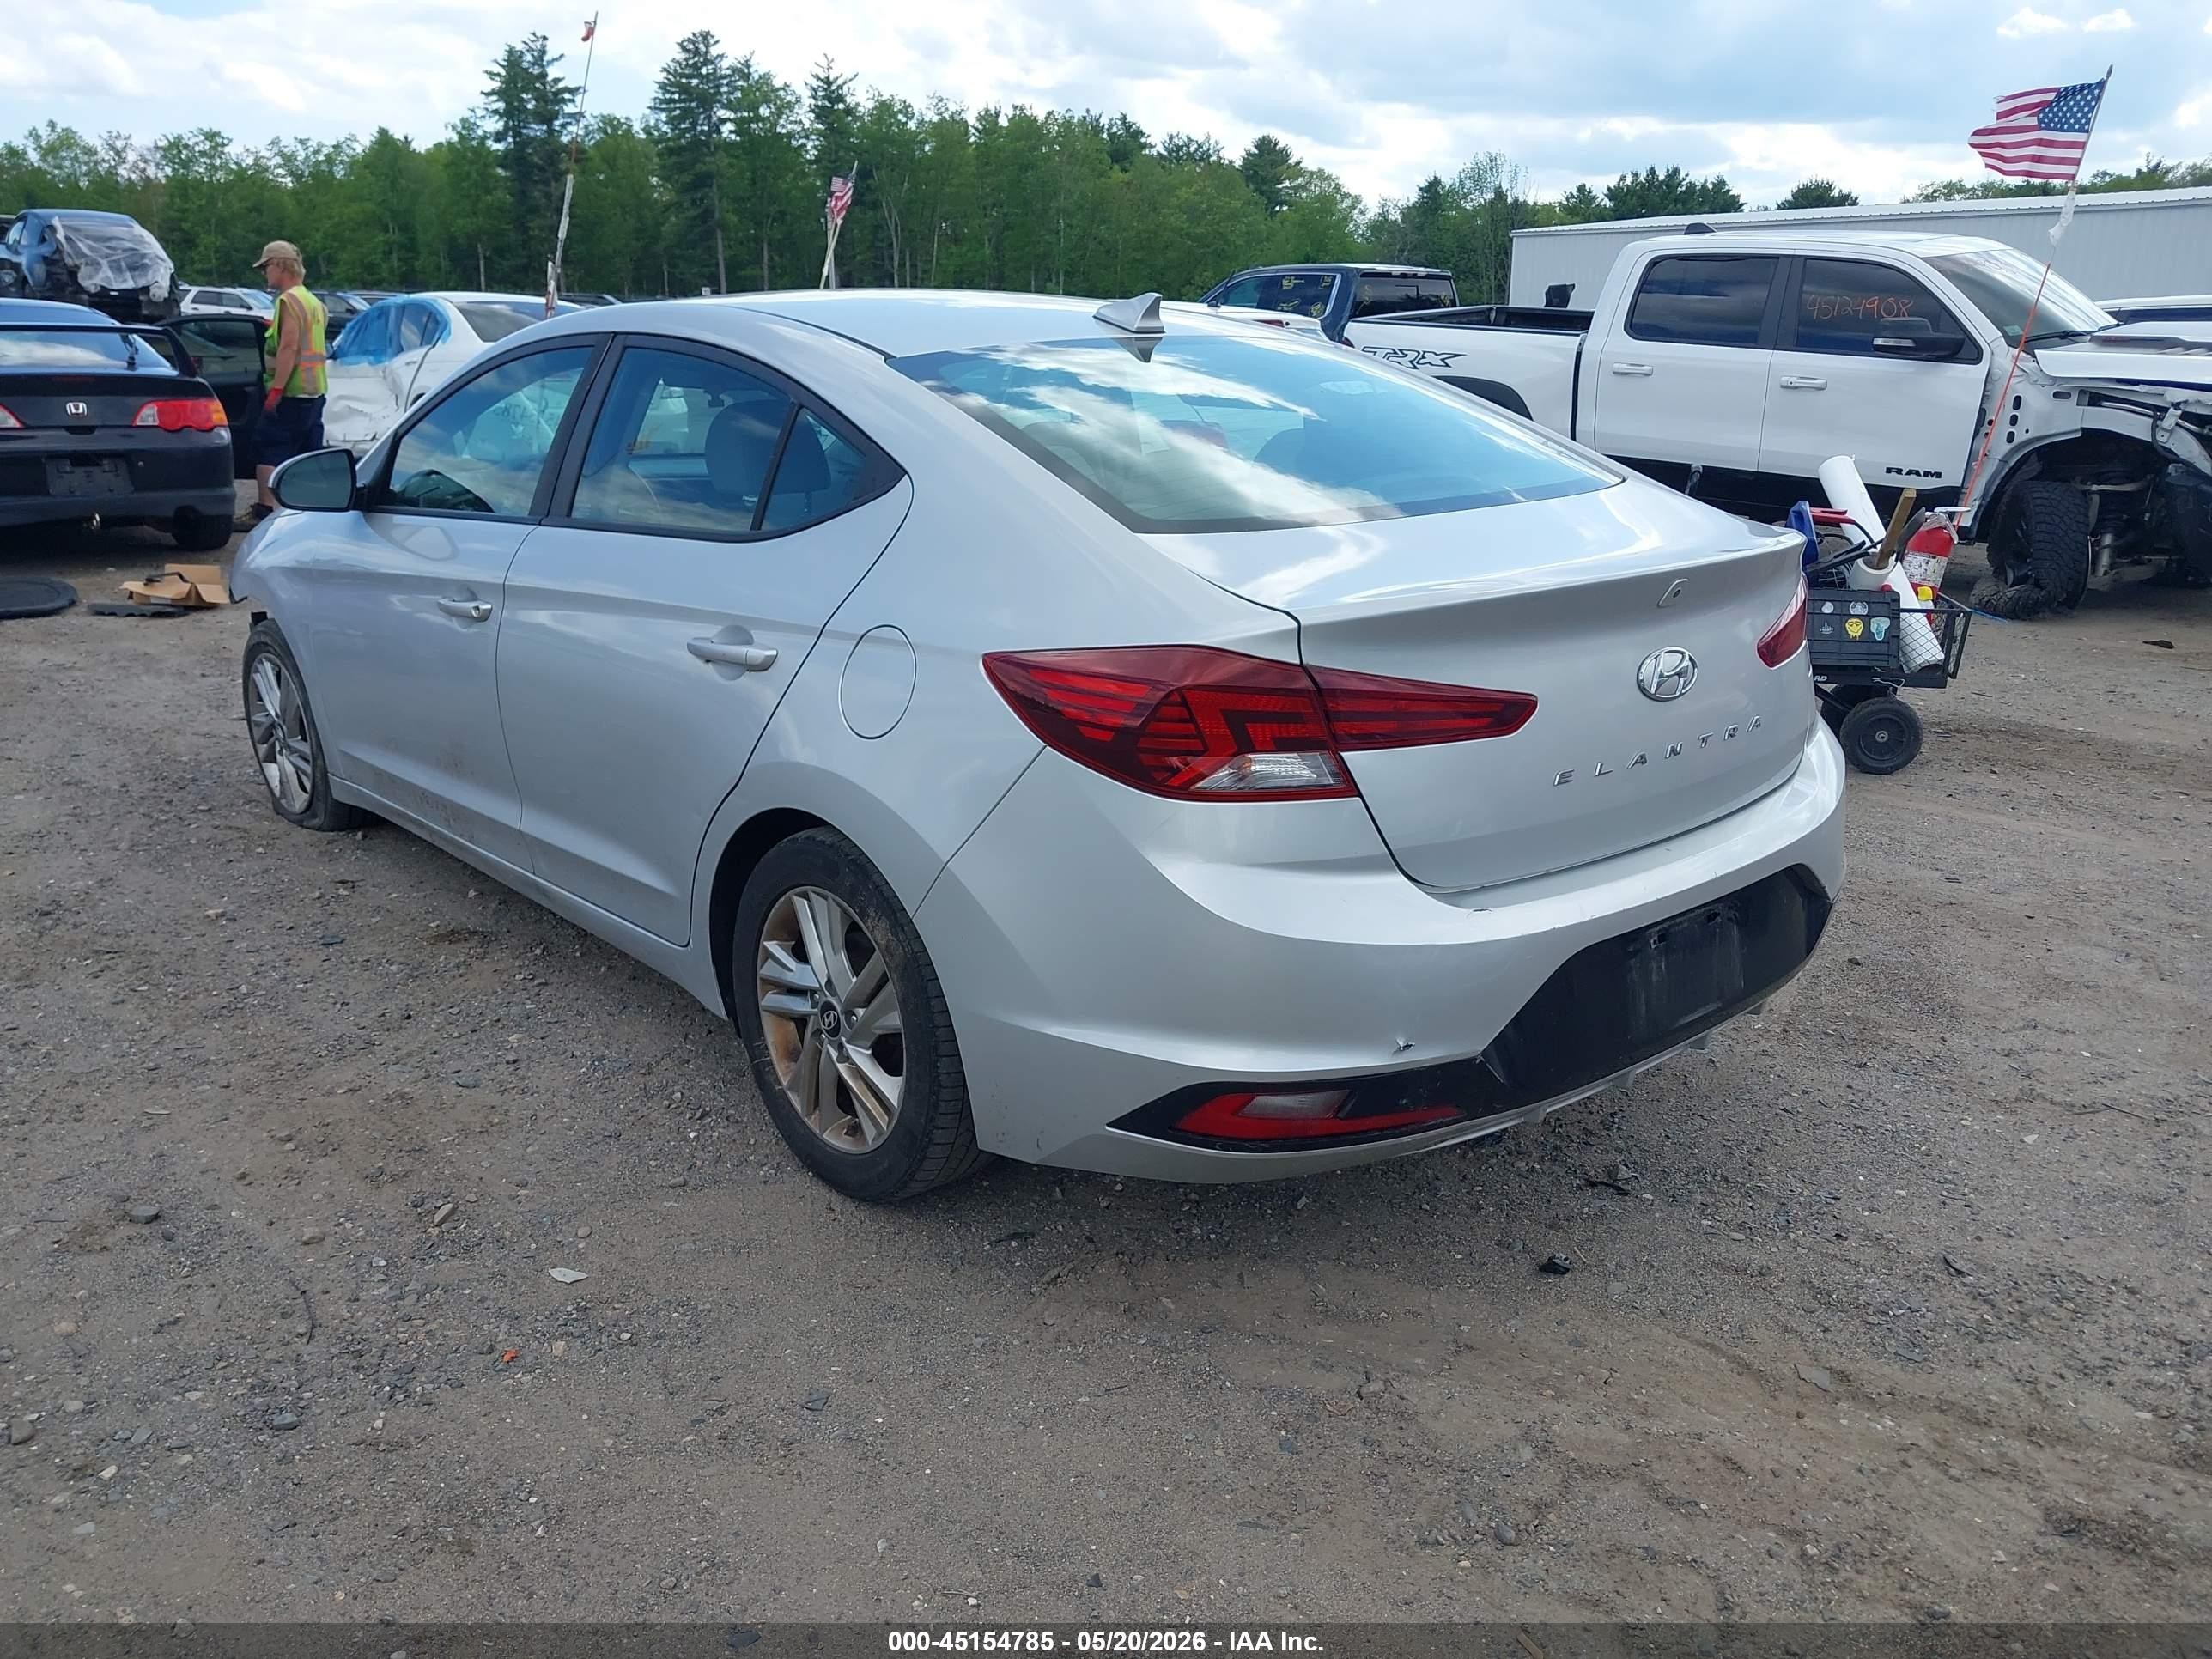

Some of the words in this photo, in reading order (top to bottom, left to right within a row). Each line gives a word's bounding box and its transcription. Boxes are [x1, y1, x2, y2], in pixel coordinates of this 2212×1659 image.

[1361, 346, 1467, 369] TRX
[1885, 466, 1942, 479] RAM
[1553, 715, 1762, 786] ELANTRA
